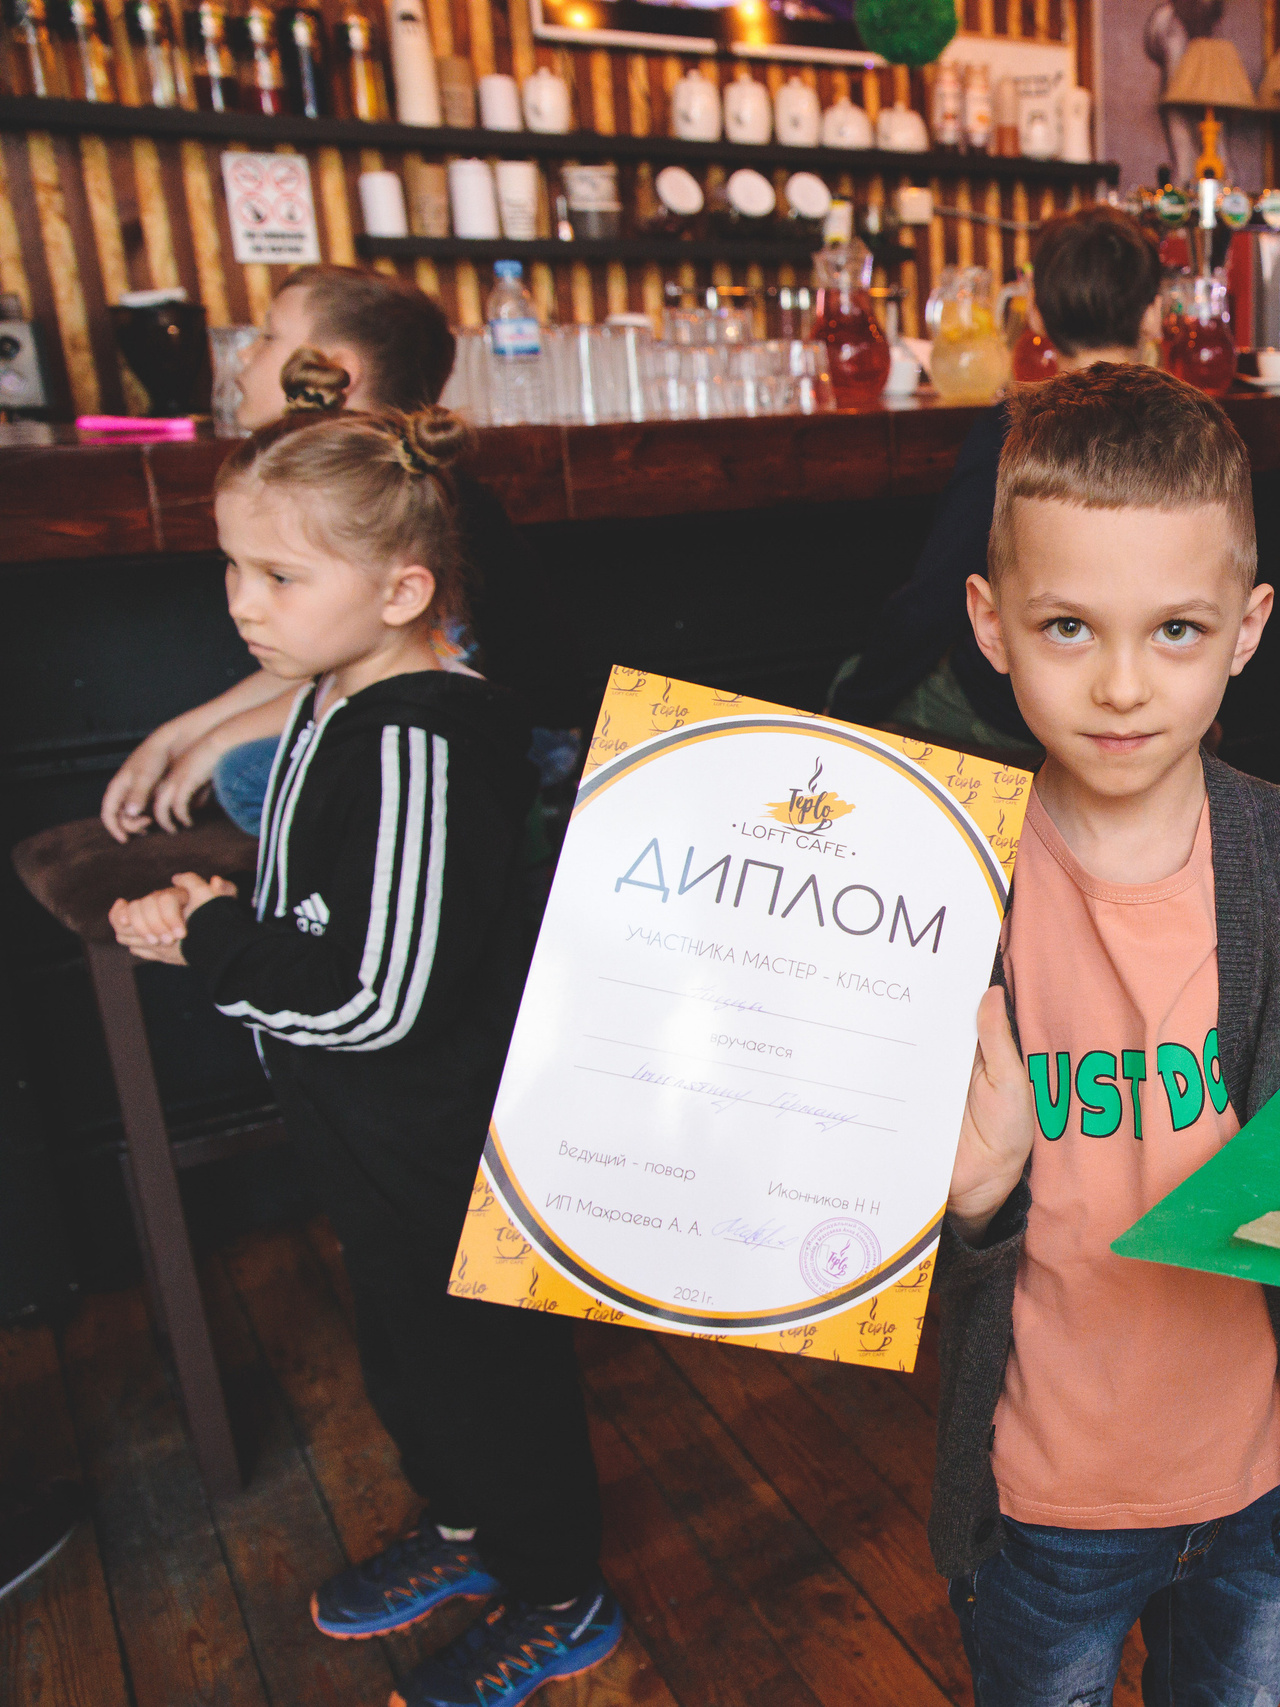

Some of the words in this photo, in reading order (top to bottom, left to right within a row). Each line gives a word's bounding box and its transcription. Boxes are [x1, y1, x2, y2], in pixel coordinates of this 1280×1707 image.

[789, 788, 834, 824] Teplo
[741, 822, 791, 844] LOFT
[796, 835, 847, 859] CAFE
[615, 838, 946, 954] ДИПЛОМ
[625, 925, 735, 964] УЧАСТНИКА
[742, 950, 817, 979] МАСТЕР
[837, 971, 911, 1003] КЛАССА
[710, 1034, 792, 1058] вручается
[1027, 1049, 1147, 1142] UST
[559, 1140, 626, 1167] Ведущий
[644, 1162, 696, 1182] повар
[546, 1193, 572, 1211] ИП
[576, 1198, 662, 1229] Махраева
[668, 1217, 682, 1233] А.
[688, 1220, 702, 1236] А.
[768, 1181, 849, 1209] Иконников
[673, 1286, 715, 1311] 2021г.
